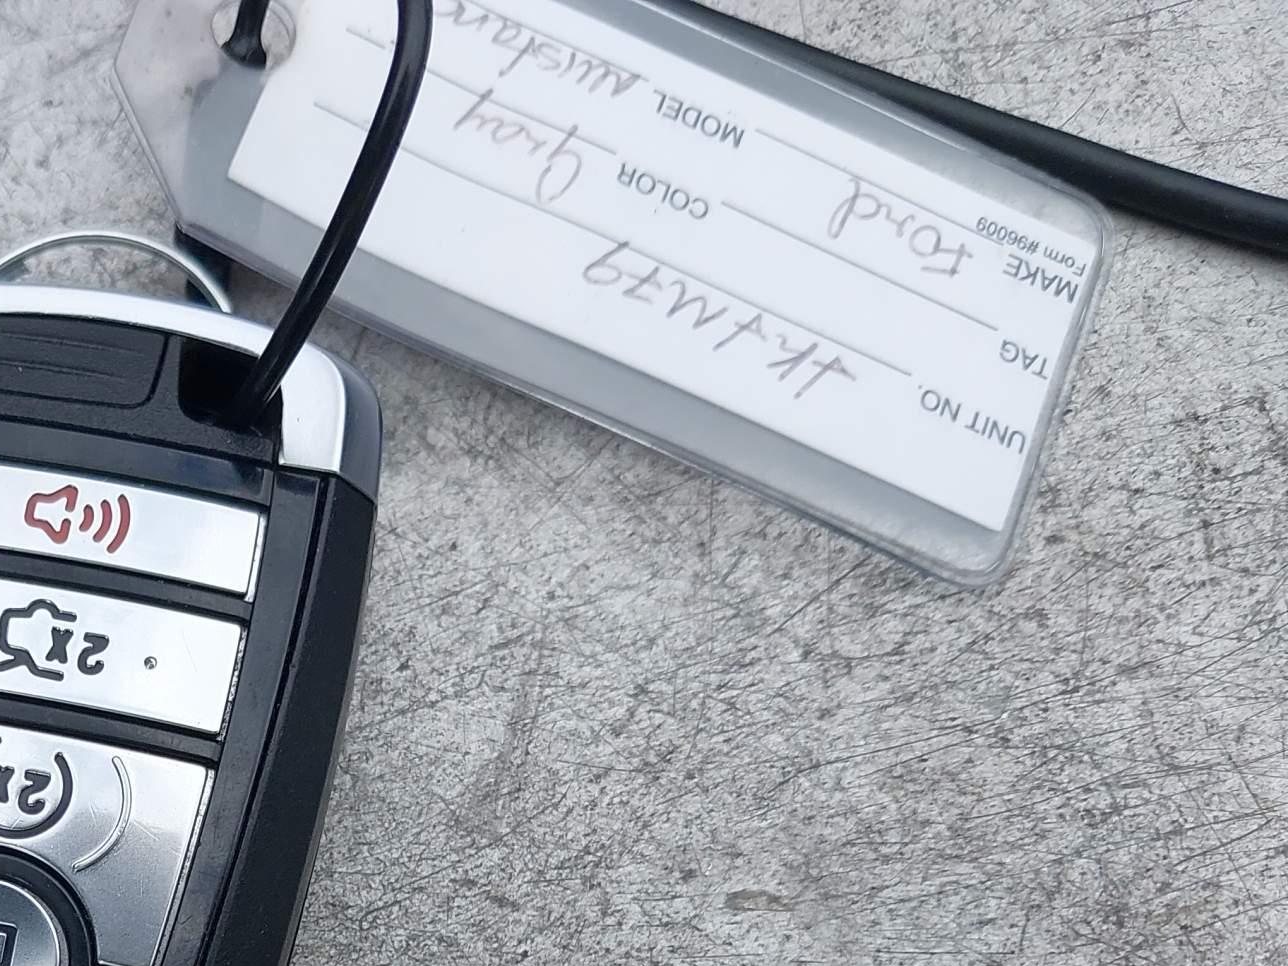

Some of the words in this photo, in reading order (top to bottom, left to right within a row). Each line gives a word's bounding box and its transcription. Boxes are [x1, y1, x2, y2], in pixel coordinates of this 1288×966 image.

[434, 0, 641, 98] Mustan
[653, 89, 745, 148] MODEL
[453, 87, 582, 203] Gray
[616, 162, 710, 220] COLOR
[975, 216, 1040, 253] #96009
[1002, 252, 1079, 304] MAKE
[1043, 246, 1087, 277] Form
[998, 338, 1049, 380] TAG
[917, 384, 962, 423] NO.
[964, 410, 1027, 454] UNIT
